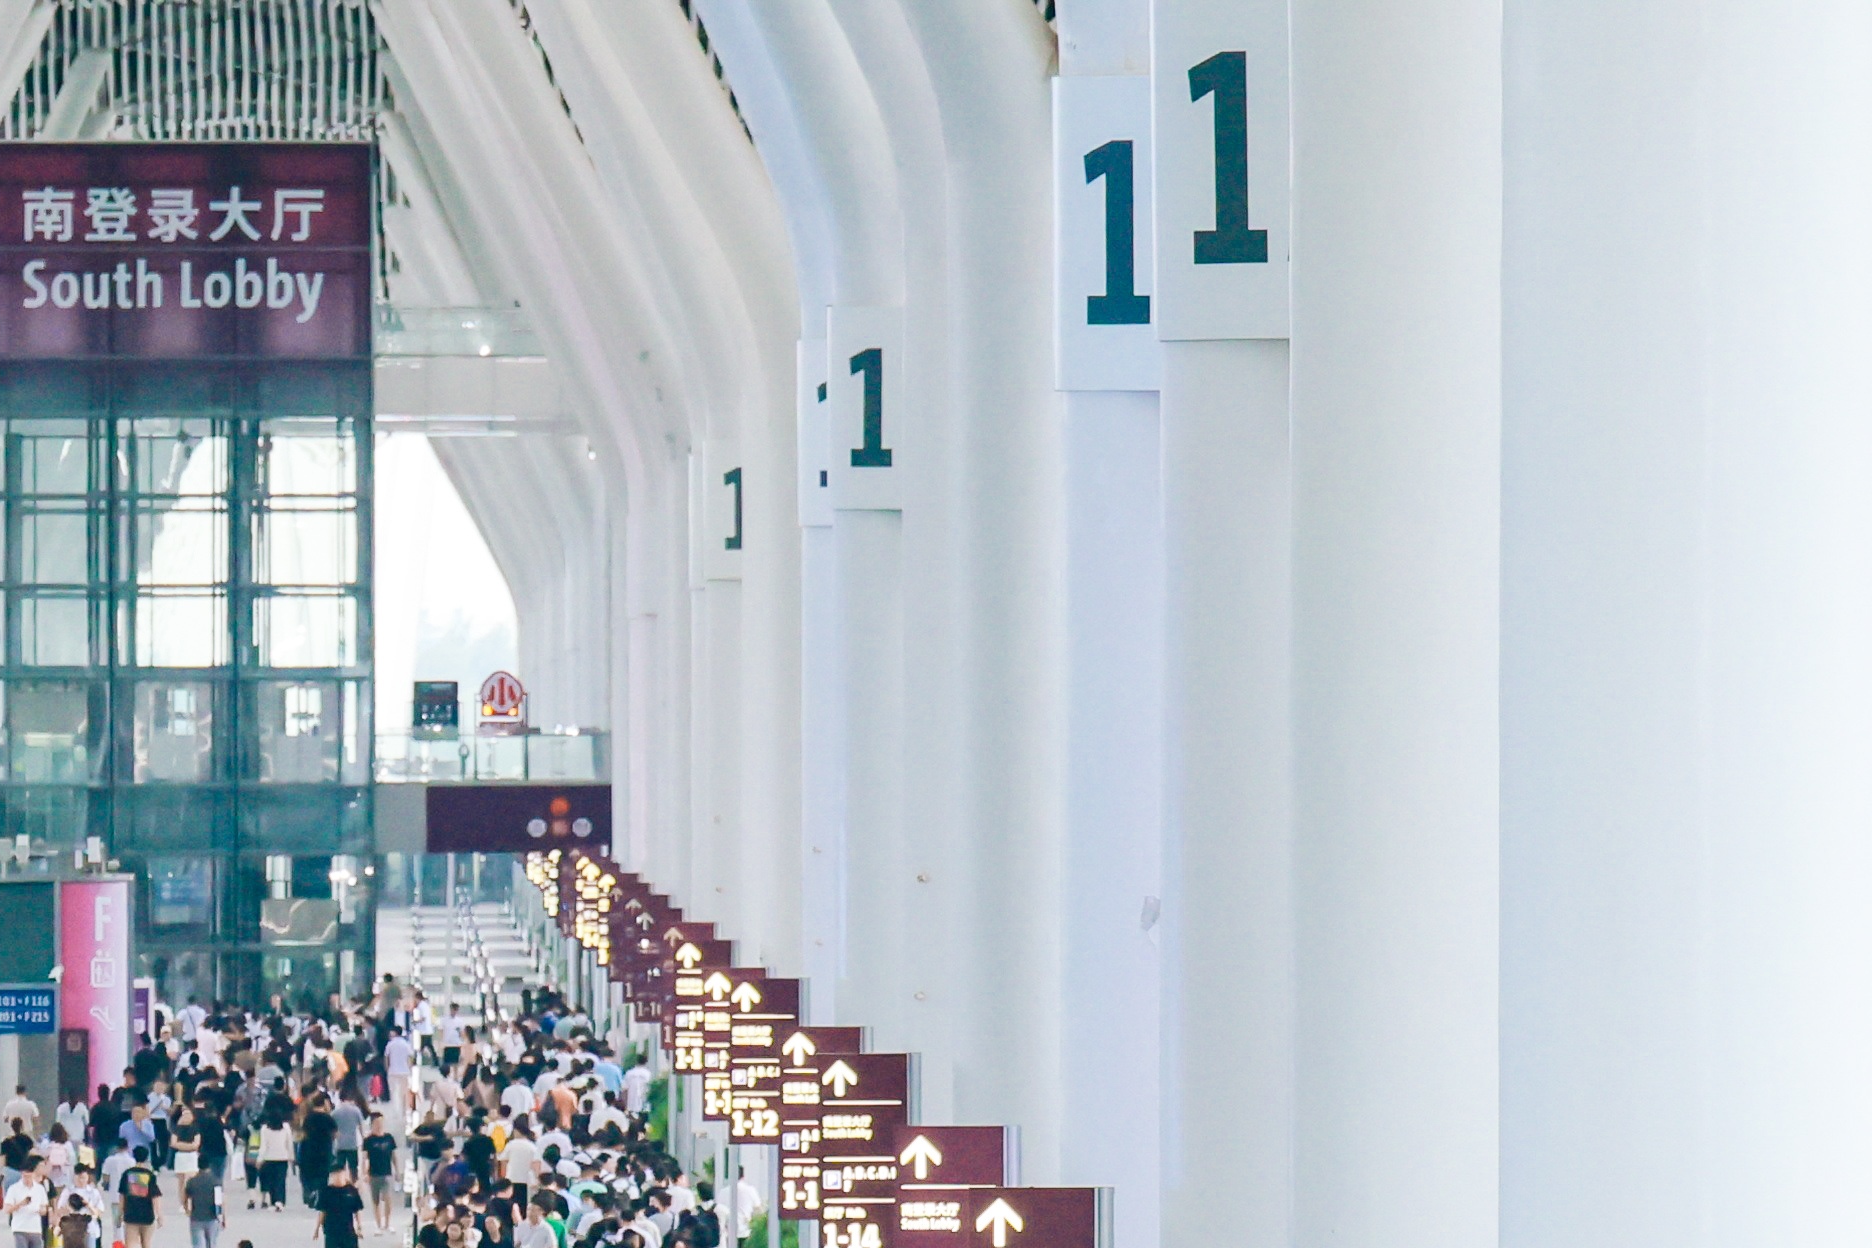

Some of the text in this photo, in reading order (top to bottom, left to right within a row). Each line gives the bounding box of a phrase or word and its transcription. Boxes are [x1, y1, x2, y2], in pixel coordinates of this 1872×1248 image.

[22, 186, 326, 243] 南登录大厅
[22, 257, 325, 324] South Lobby
[94, 896, 113, 942] F
[676, 1047, 703, 1070] 1-1
[705, 1090, 732, 1115] 1-1
[732, 1110, 779, 1137] 1-12
[782, 1180, 821, 1210] 1-1
